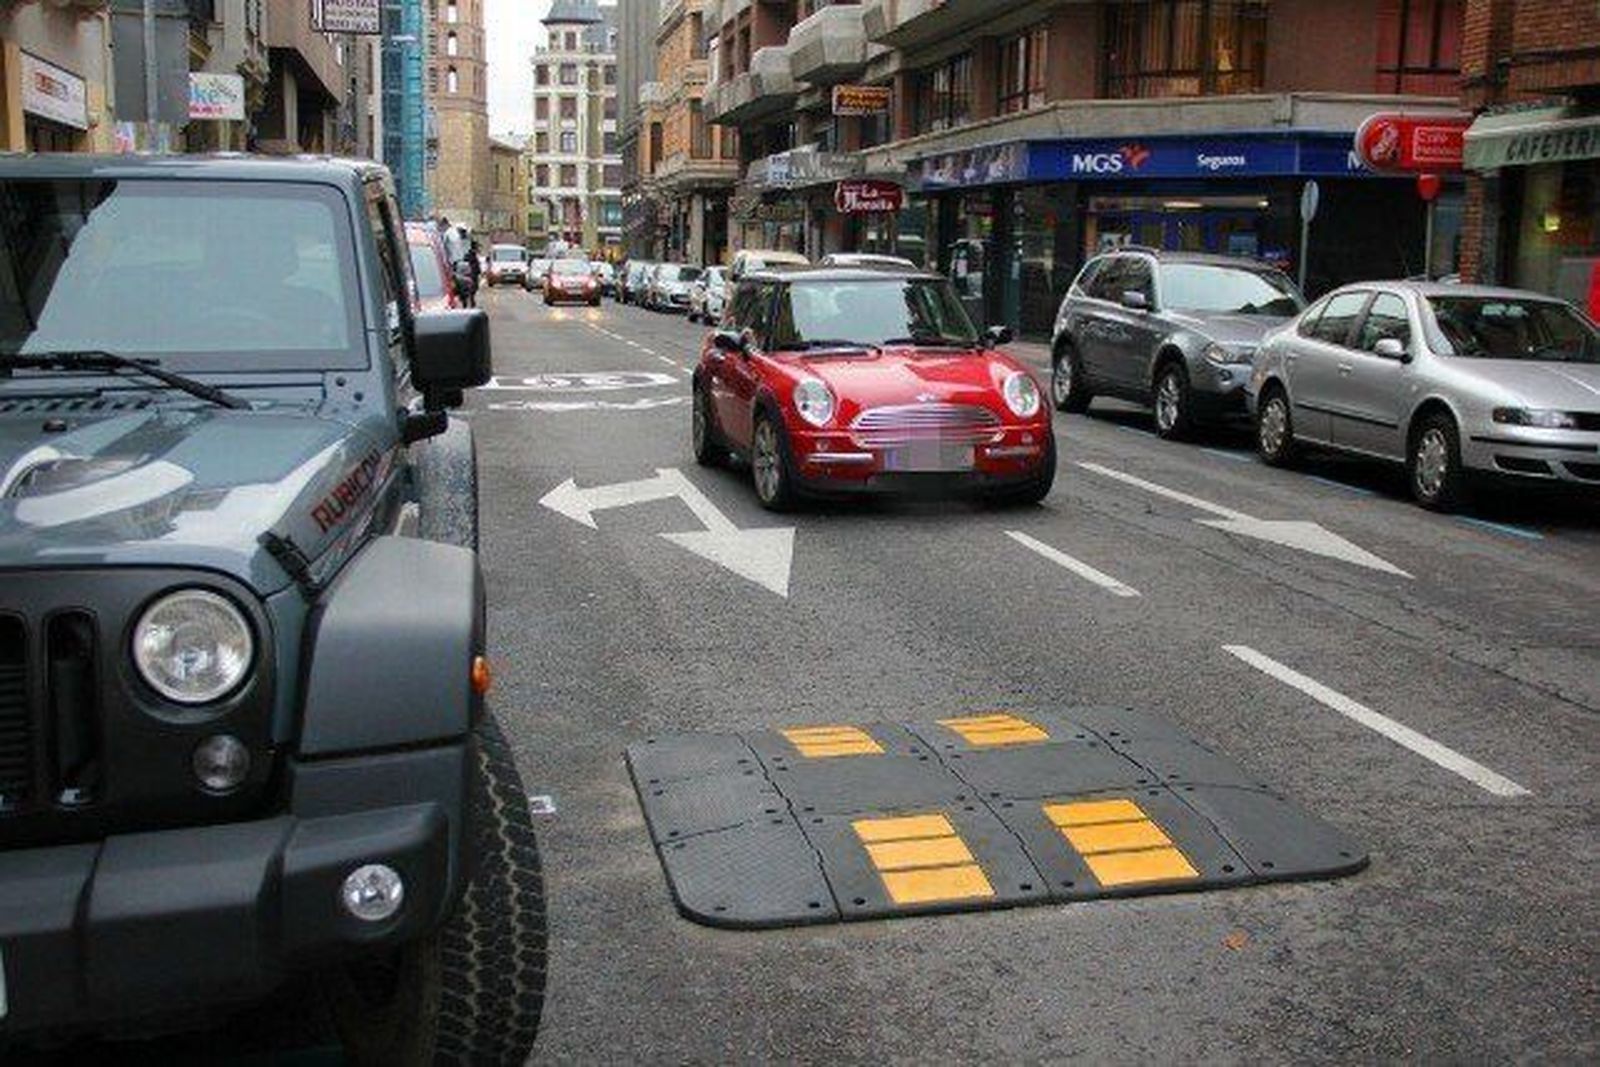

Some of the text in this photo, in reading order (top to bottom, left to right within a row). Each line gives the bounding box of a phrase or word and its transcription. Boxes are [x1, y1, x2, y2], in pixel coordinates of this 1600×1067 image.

[1072, 153, 1246, 173] MGS Seguros
[311, 447, 382, 535] RUBICON
